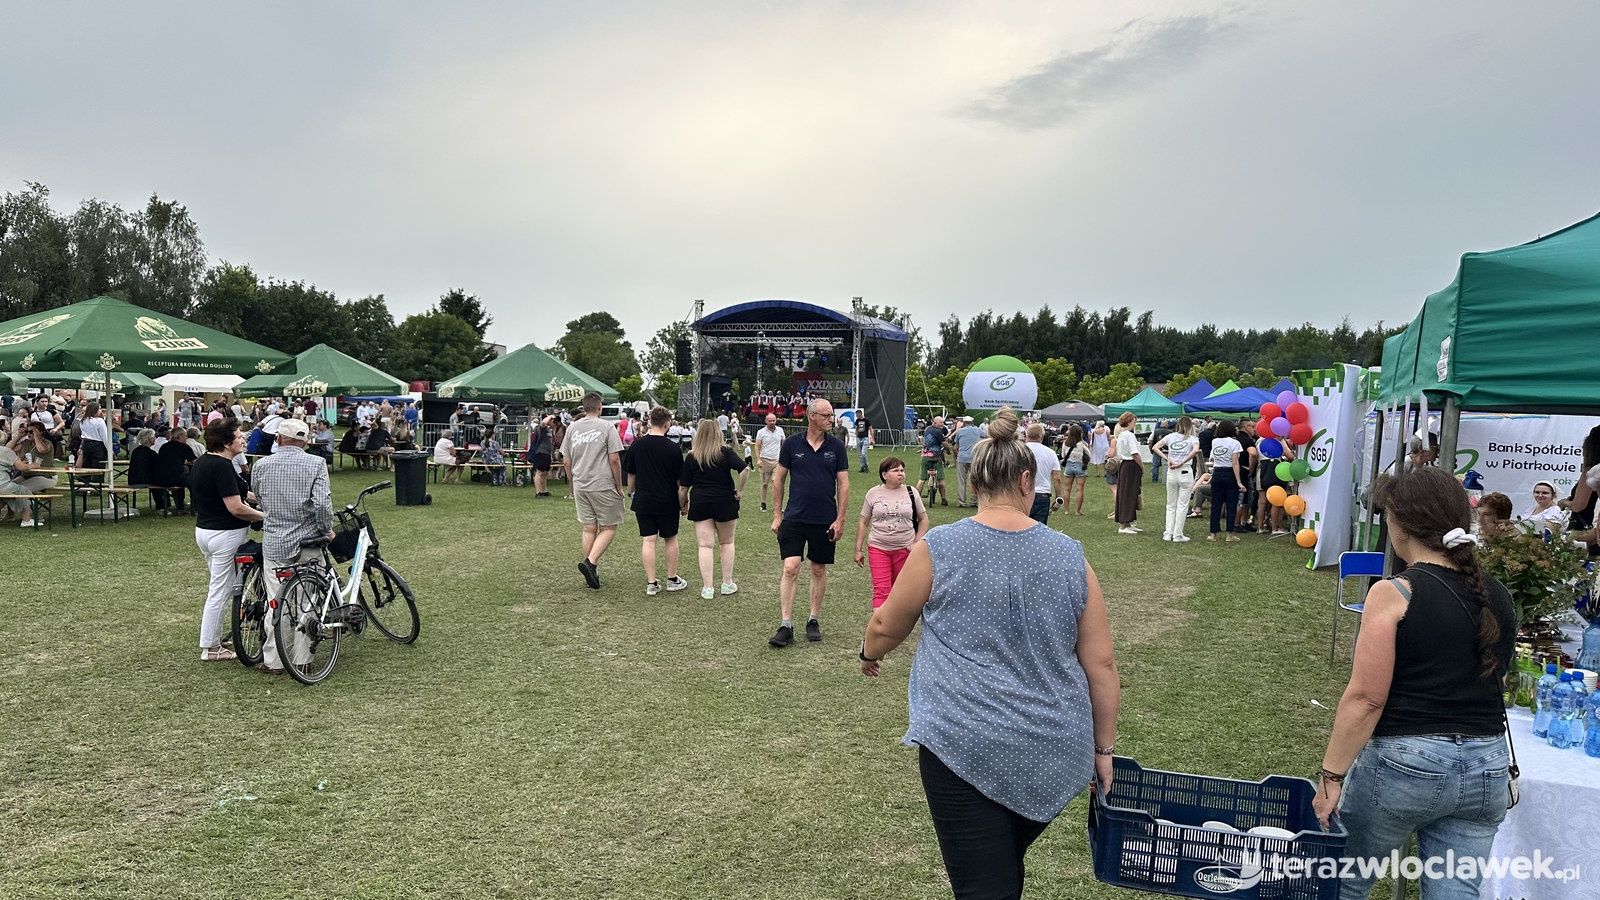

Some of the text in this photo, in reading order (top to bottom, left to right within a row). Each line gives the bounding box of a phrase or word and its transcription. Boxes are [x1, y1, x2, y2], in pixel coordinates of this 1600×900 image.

[149, 339, 200, 349] ZUBR
[288, 385, 323, 397] ZUBR
[807, 380, 833, 390] XXIX
[549, 388, 582, 401] ZUBR
[1311, 446, 1328, 463] SGB
[1488, 442, 1582, 457] Bank Spółdzie
[1486, 460, 1499, 469] w
[1502, 459, 1577, 473] Piotrkowie
[1553, 477, 1572, 486] rok
